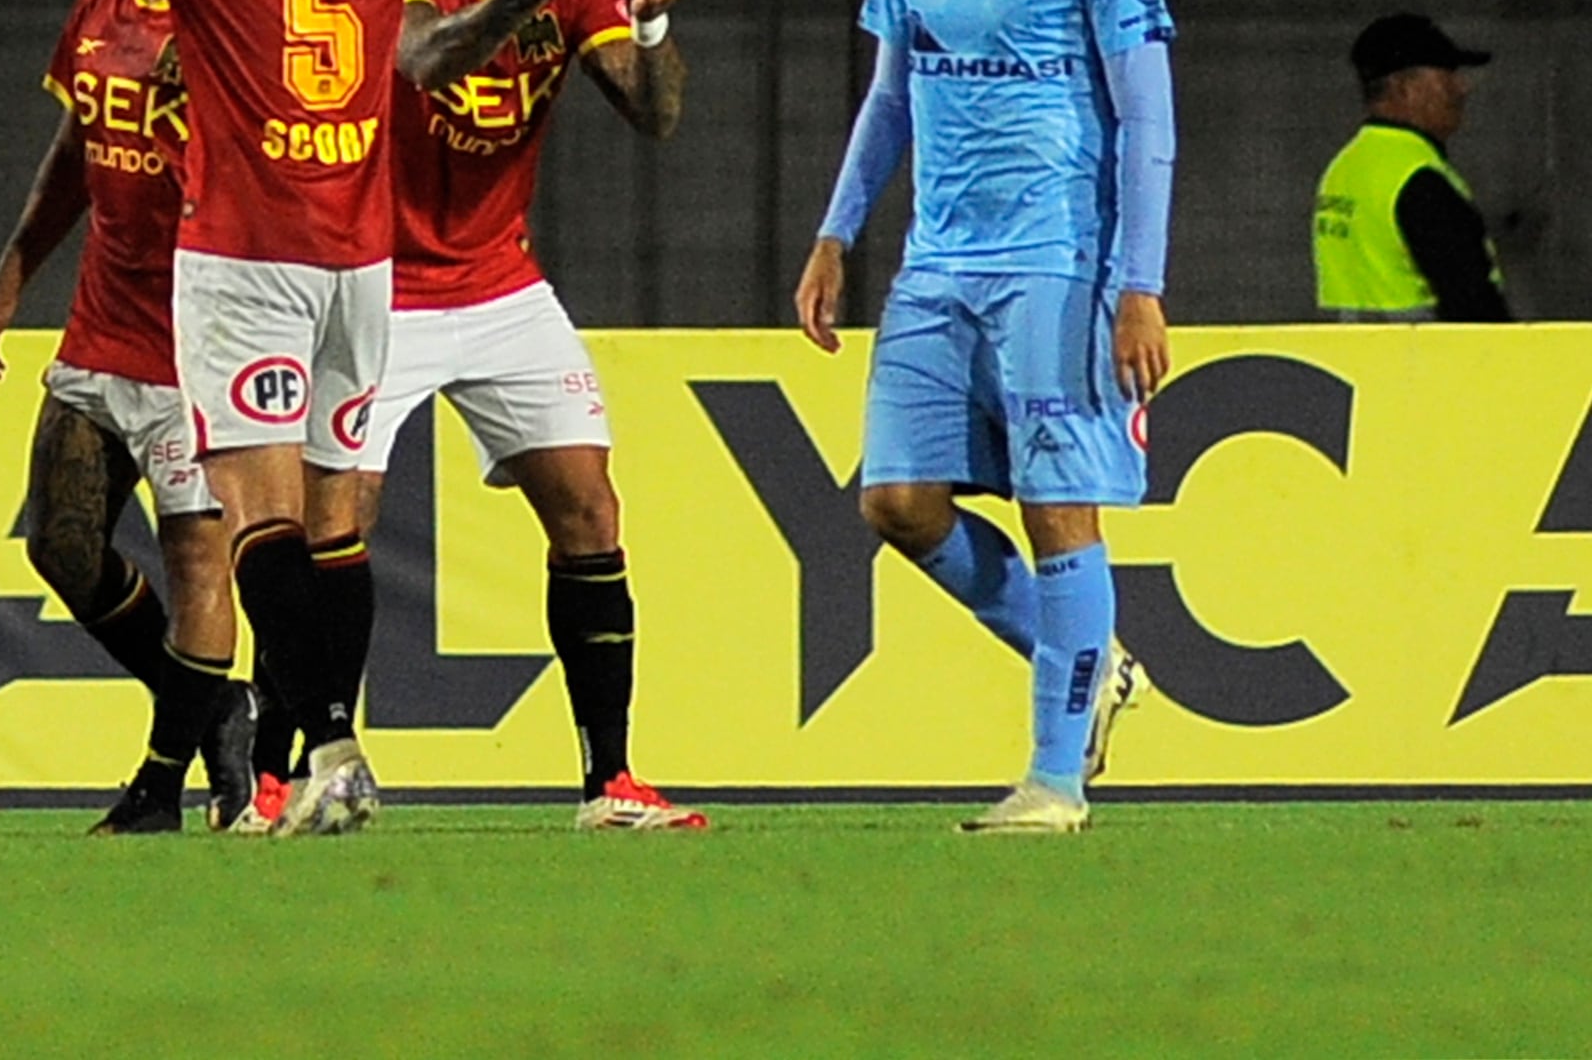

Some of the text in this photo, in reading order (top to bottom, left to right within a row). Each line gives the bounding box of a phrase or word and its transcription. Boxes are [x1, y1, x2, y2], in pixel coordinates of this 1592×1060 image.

[73, 71, 190, 141] SEK
[85, 140, 164, 175] mundo
[254, 369, 299, 411] PF
